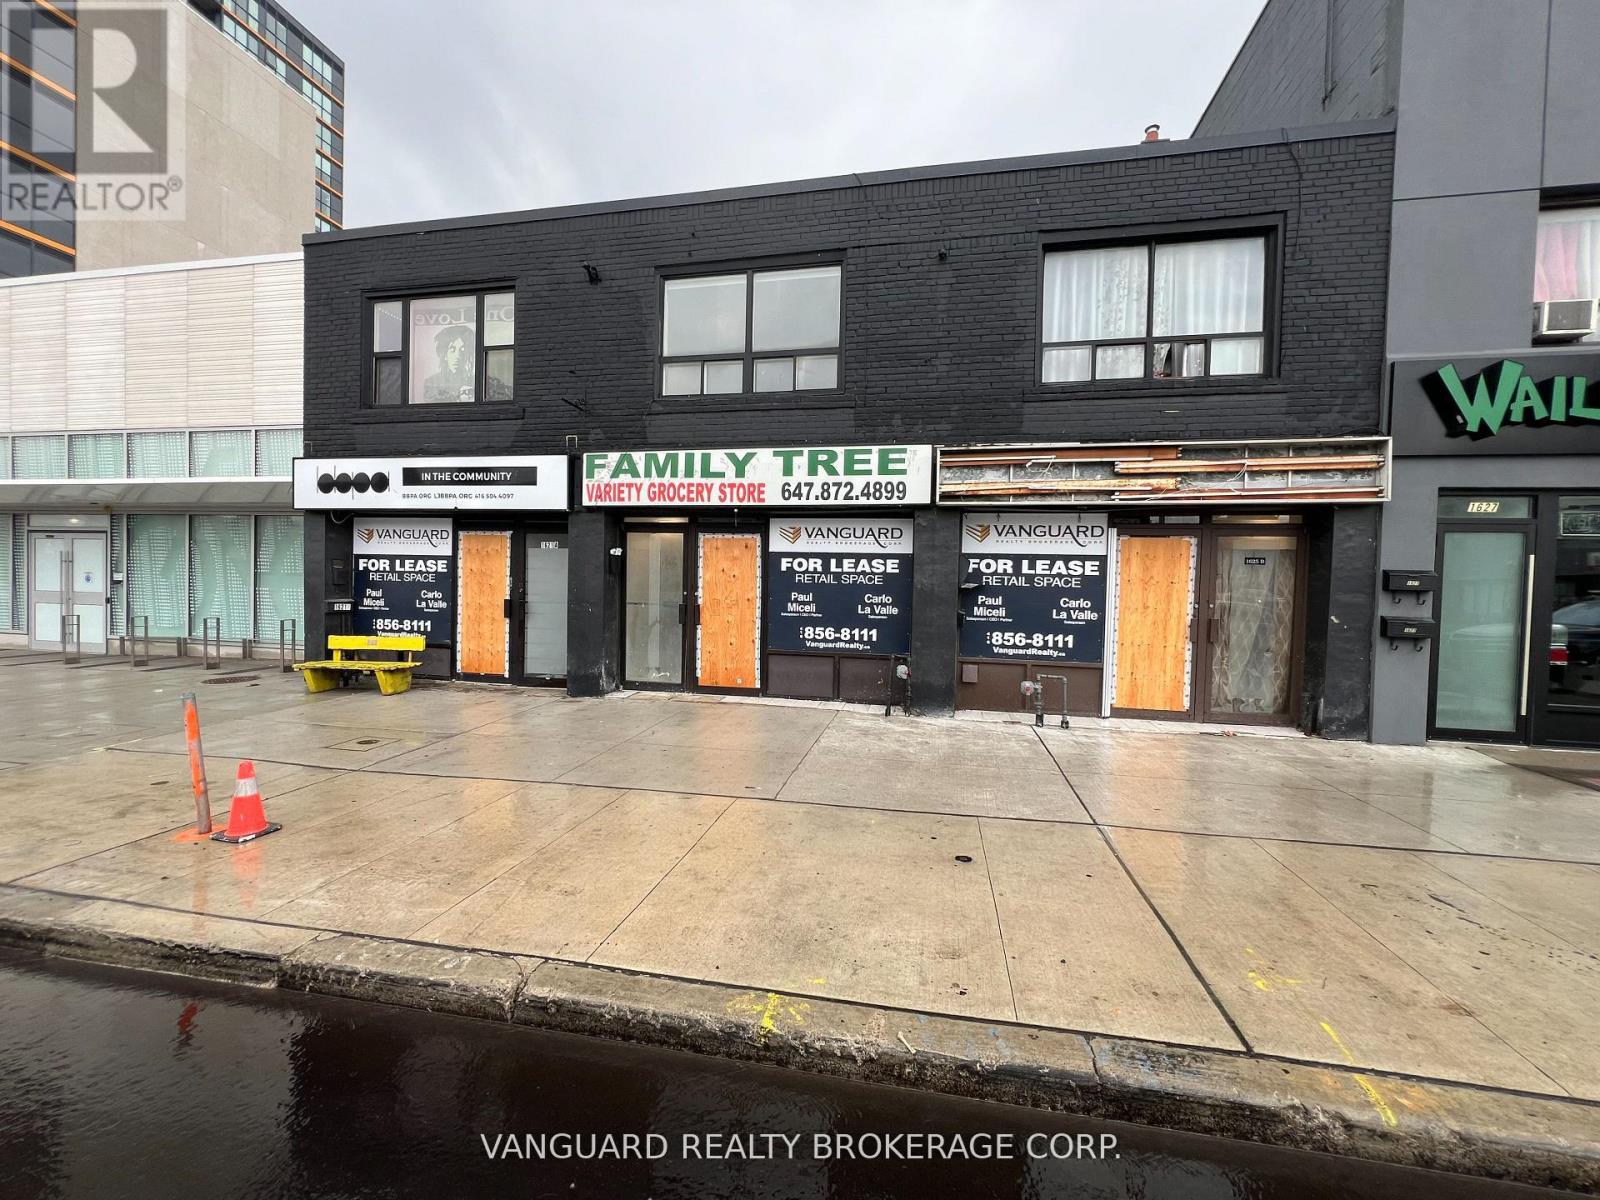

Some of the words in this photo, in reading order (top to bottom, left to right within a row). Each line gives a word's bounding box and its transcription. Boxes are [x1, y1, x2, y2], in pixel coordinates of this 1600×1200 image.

[585, 452, 757, 479] FAMILY
[773, 448, 907, 477] TREE
[421, 472, 431, 481] IN
[432, 472, 451, 481] THE
[452, 472, 512, 481] COMMUNITY
[586, 483, 643, 502] VARIETY
[647, 482, 713, 502] GROCERY
[718, 482, 765, 502] STORE
[781, 481, 907, 501] 647.872.4899
[1470, 503, 1498, 512] 1627
[375, 528, 449, 546] VANGUARD
[804, 527, 903, 546] VANGUARD
[993, 525, 1104, 545] VANGUARD
[358, 559, 390, 571] FOR
[395, 559, 448, 572] LEASE
[780, 558, 822, 572] FOR
[830, 558, 900, 573] LEASE
[968, 559, 1013, 574] FOR
[1021, 559, 1100, 576] LEASE
[369, 572, 401, 582] RETAIL
[403, 573, 436, 583] SPACE
[795, 573, 838, 584] RETAIL
[841, 574, 883, 585] SPACE
[982, 575, 1030, 587] RETAIL
[1034, 577, 1081, 588] SPACE
[366, 588, 382, 597] Paul
[421, 590, 443, 599] Carlo
[791, 592, 813, 602] Paul
[363, 598, 385, 607] Miceli
[864, 593, 892, 604] Carlo
[977, 595, 1002, 605] Paul
[1060, 597, 1091, 608] Carlo
[416, 600, 426, 608] La
[428, 600, 447, 609] Valle
[787, 602, 816, 612] Miceli
[857, 604, 871, 614] La
[873, 604, 898, 615] Valle
[973, 606, 1006, 617] Miceli
[1052, 609, 1067, 619] La
[1070, 609, 1098, 620] Valle
[376, 618, 431, 631] 856-8111
[804, 626, 878, 642] 856-8111
[991, 631, 1074, 649] 856-8111
